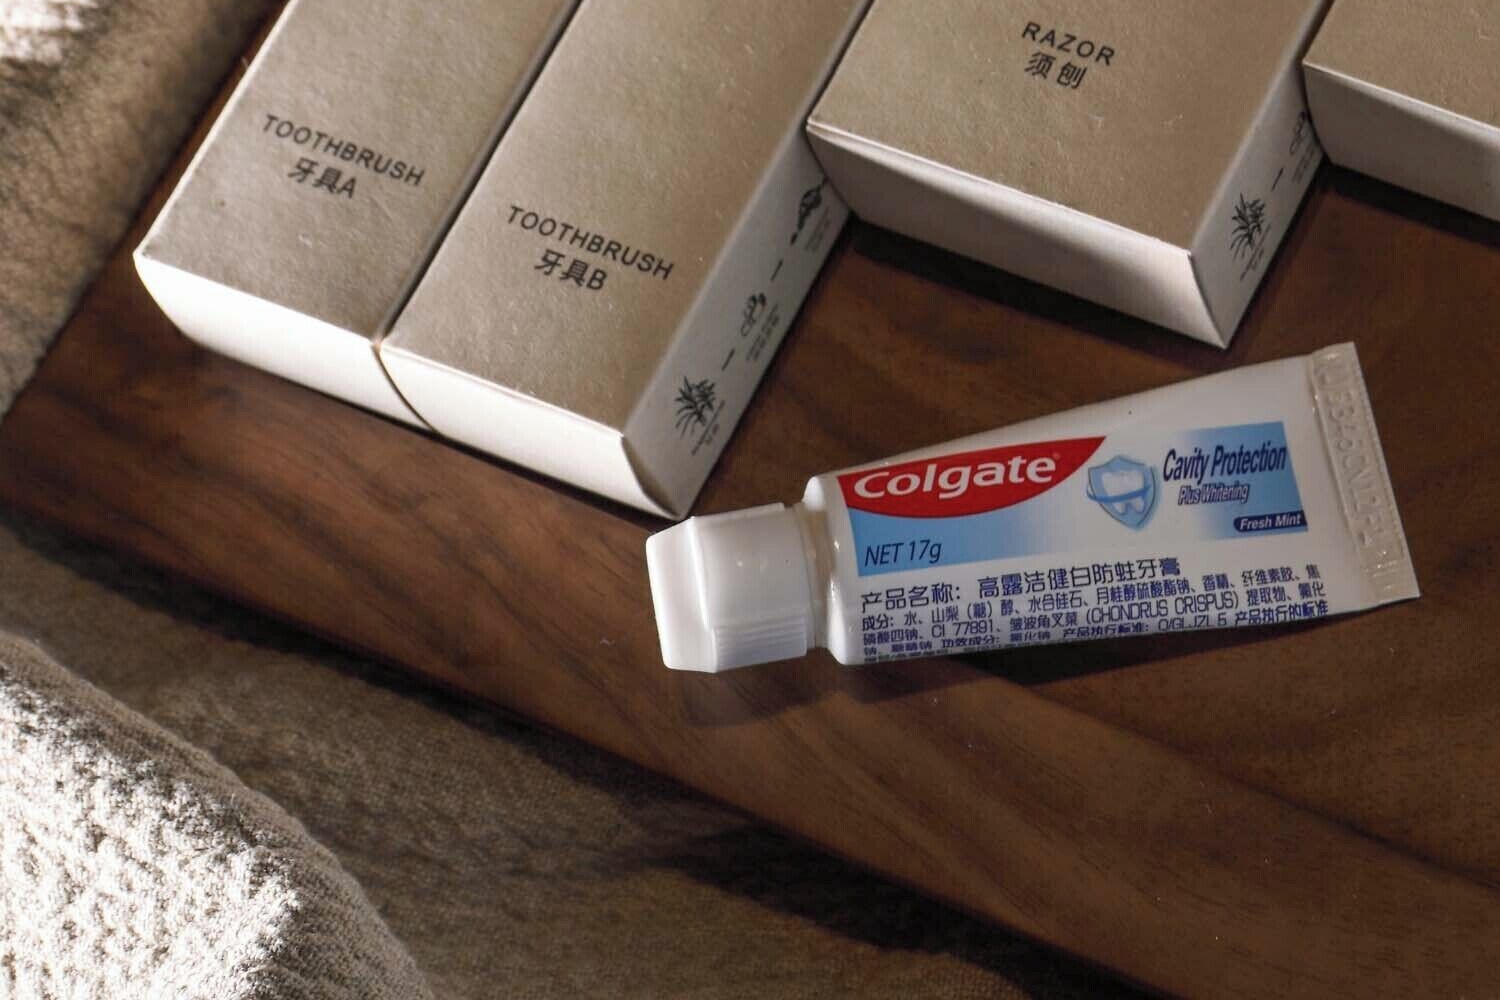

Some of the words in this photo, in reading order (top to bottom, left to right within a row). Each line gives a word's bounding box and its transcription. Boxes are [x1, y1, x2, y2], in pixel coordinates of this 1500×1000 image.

[1022, 21, 1115, 66] RAZOR
[1024, 51, 1087, 89] 须刨
[262, 113, 425, 187] TOOTHBRUSH
[288, 157, 358, 200] 牙具A
[507, 205, 675, 280] TOOTHBRUSH
[534, 249, 608, 291] 牙具B
[853, 455, 1056, 499] Colgate
[1163, 447, 1209, 485] Cavity
[1211, 440, 1287, 477] Protection
[1178, 485, 1200, 506] Plus
[1200, 481, 1250, 504] Whitening
[1240, 516, 1272, 530] Fresh
[1275, 513, 1301, 527] Mint
[864, 542, 903, 567] NET
[909, 539, 942, 564] 17g
